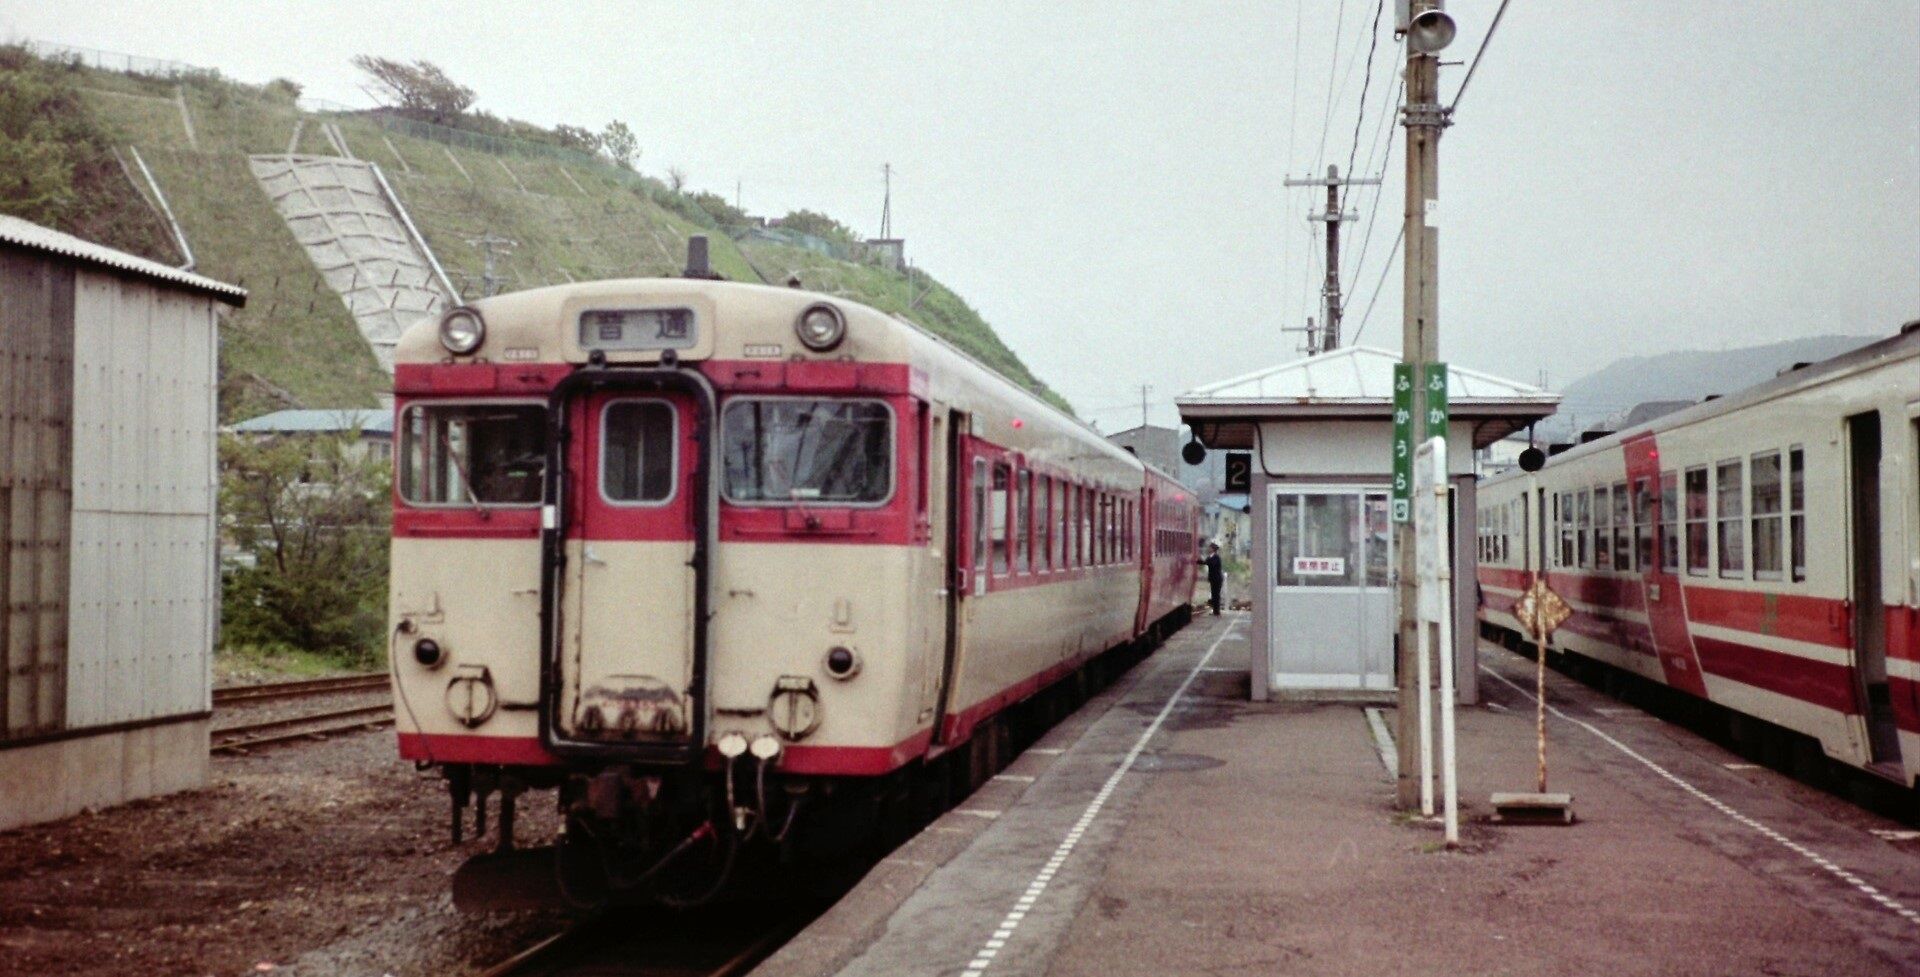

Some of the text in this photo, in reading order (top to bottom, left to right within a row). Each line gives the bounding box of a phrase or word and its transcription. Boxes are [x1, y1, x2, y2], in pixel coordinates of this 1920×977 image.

[596, 311, 687, 339] 普通
[1430, 374, 1445, 424] ふか
[1396, 375, 1410, 490] ふかうら
[1231, 461, 1246, 485] 2
